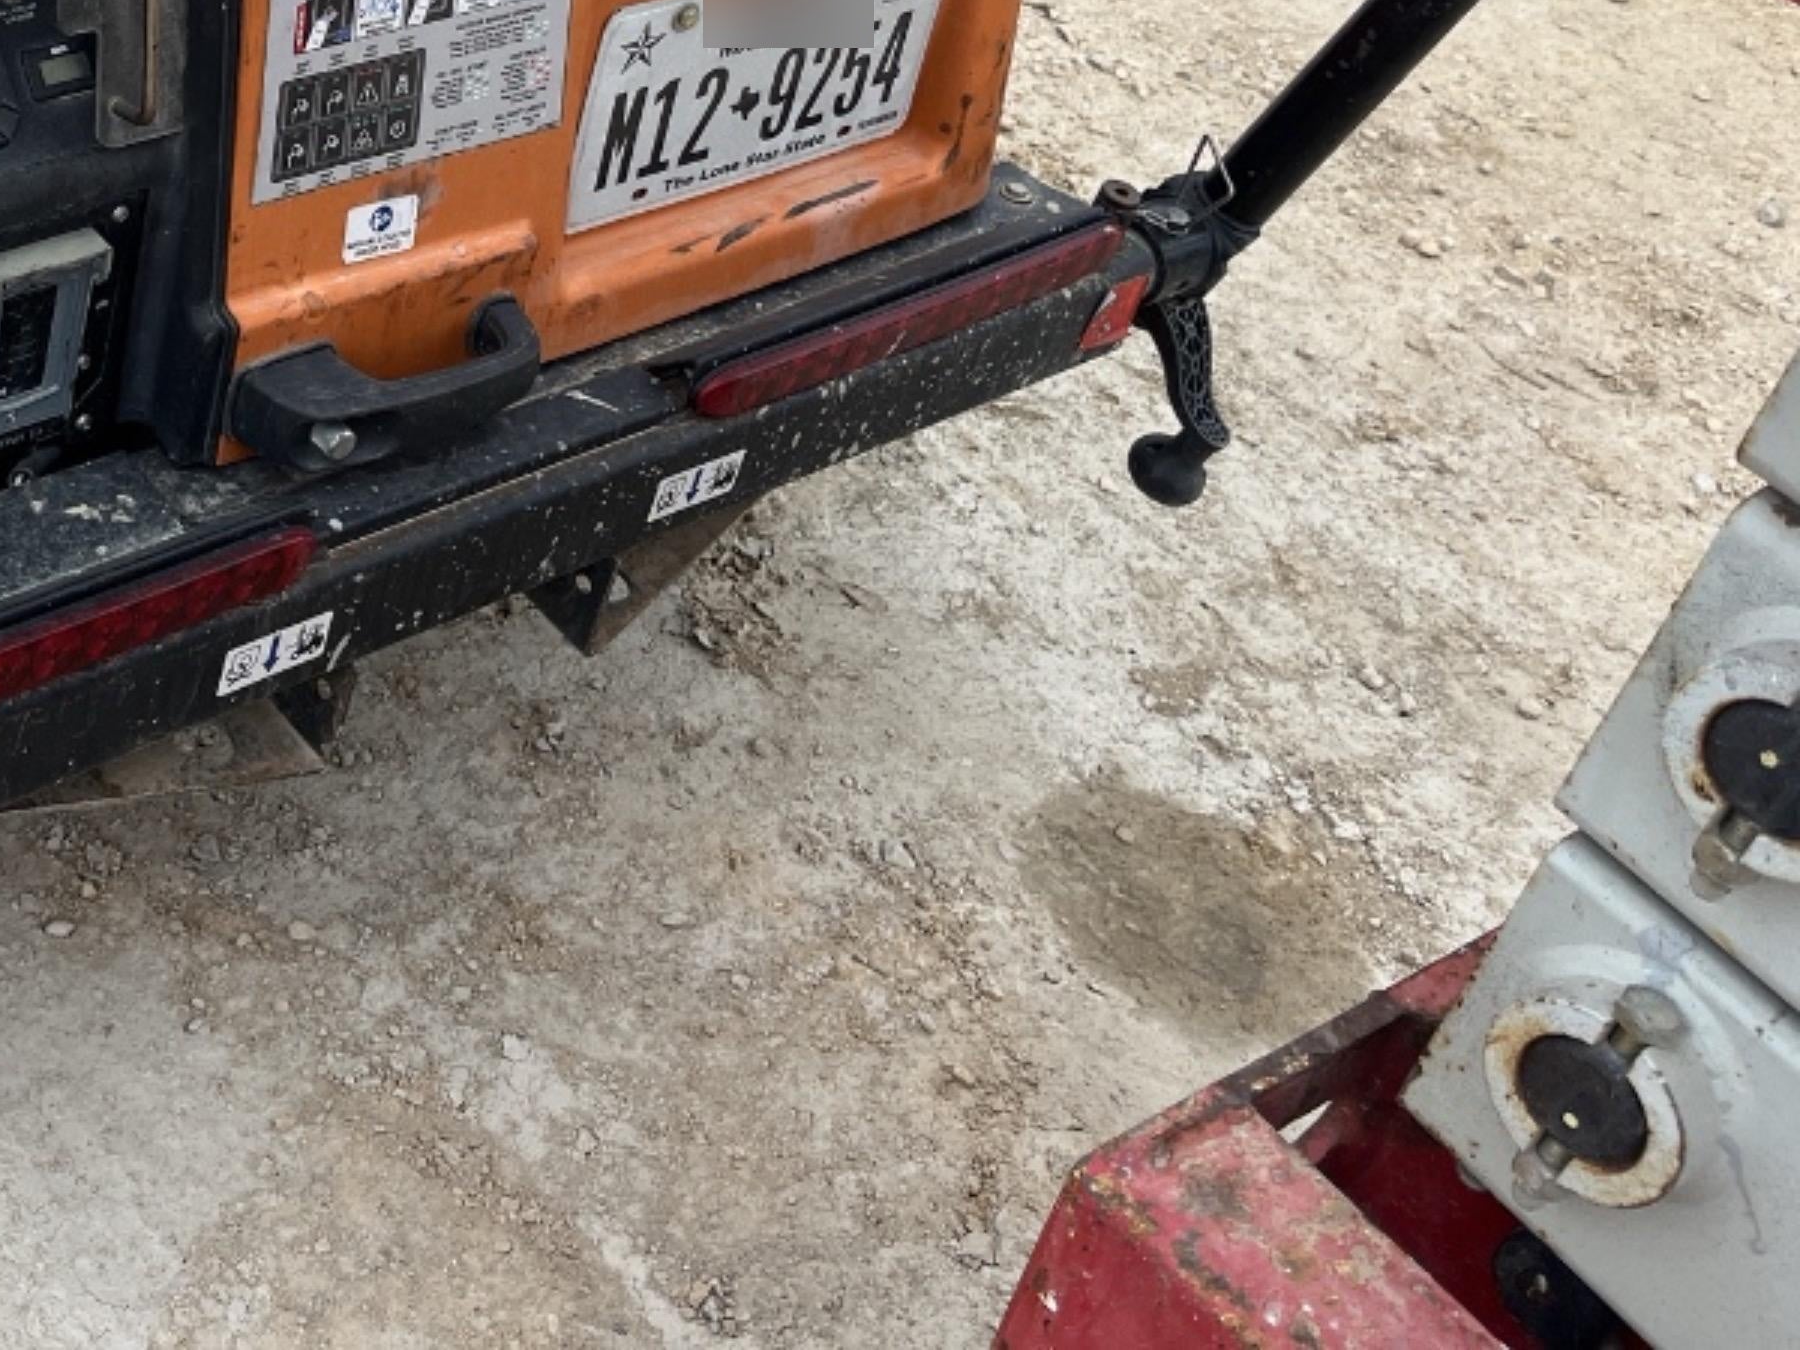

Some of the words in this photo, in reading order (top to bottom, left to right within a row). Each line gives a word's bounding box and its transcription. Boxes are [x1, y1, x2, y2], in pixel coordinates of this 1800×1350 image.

[662, 176, 694, 192] The
[699, 161, 740, 180] Lone
[746, 148, 778, 167] Star
[783, 133, 827, 154] State
